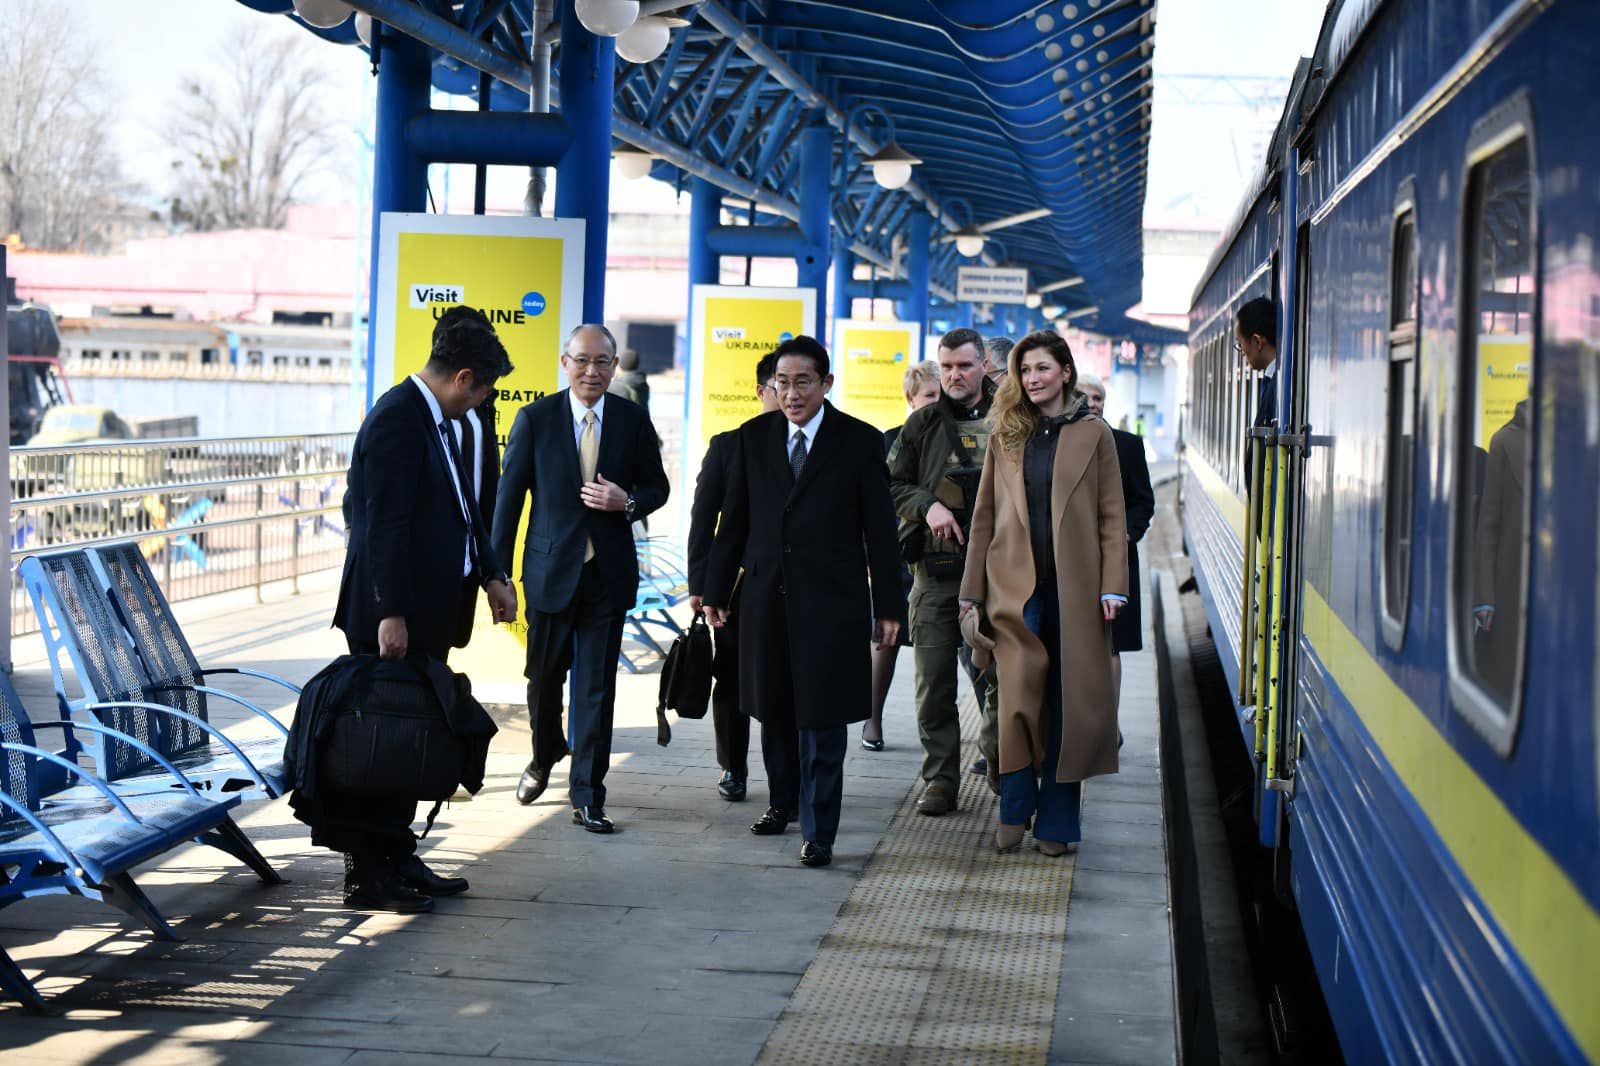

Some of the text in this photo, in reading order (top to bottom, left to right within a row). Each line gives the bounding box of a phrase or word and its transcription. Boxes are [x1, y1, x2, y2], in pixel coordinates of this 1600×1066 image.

[416, 288, 458, 303] Visit
[432, 307, 526, 324] UAINE
[715, 329, 742, 339] Visit
